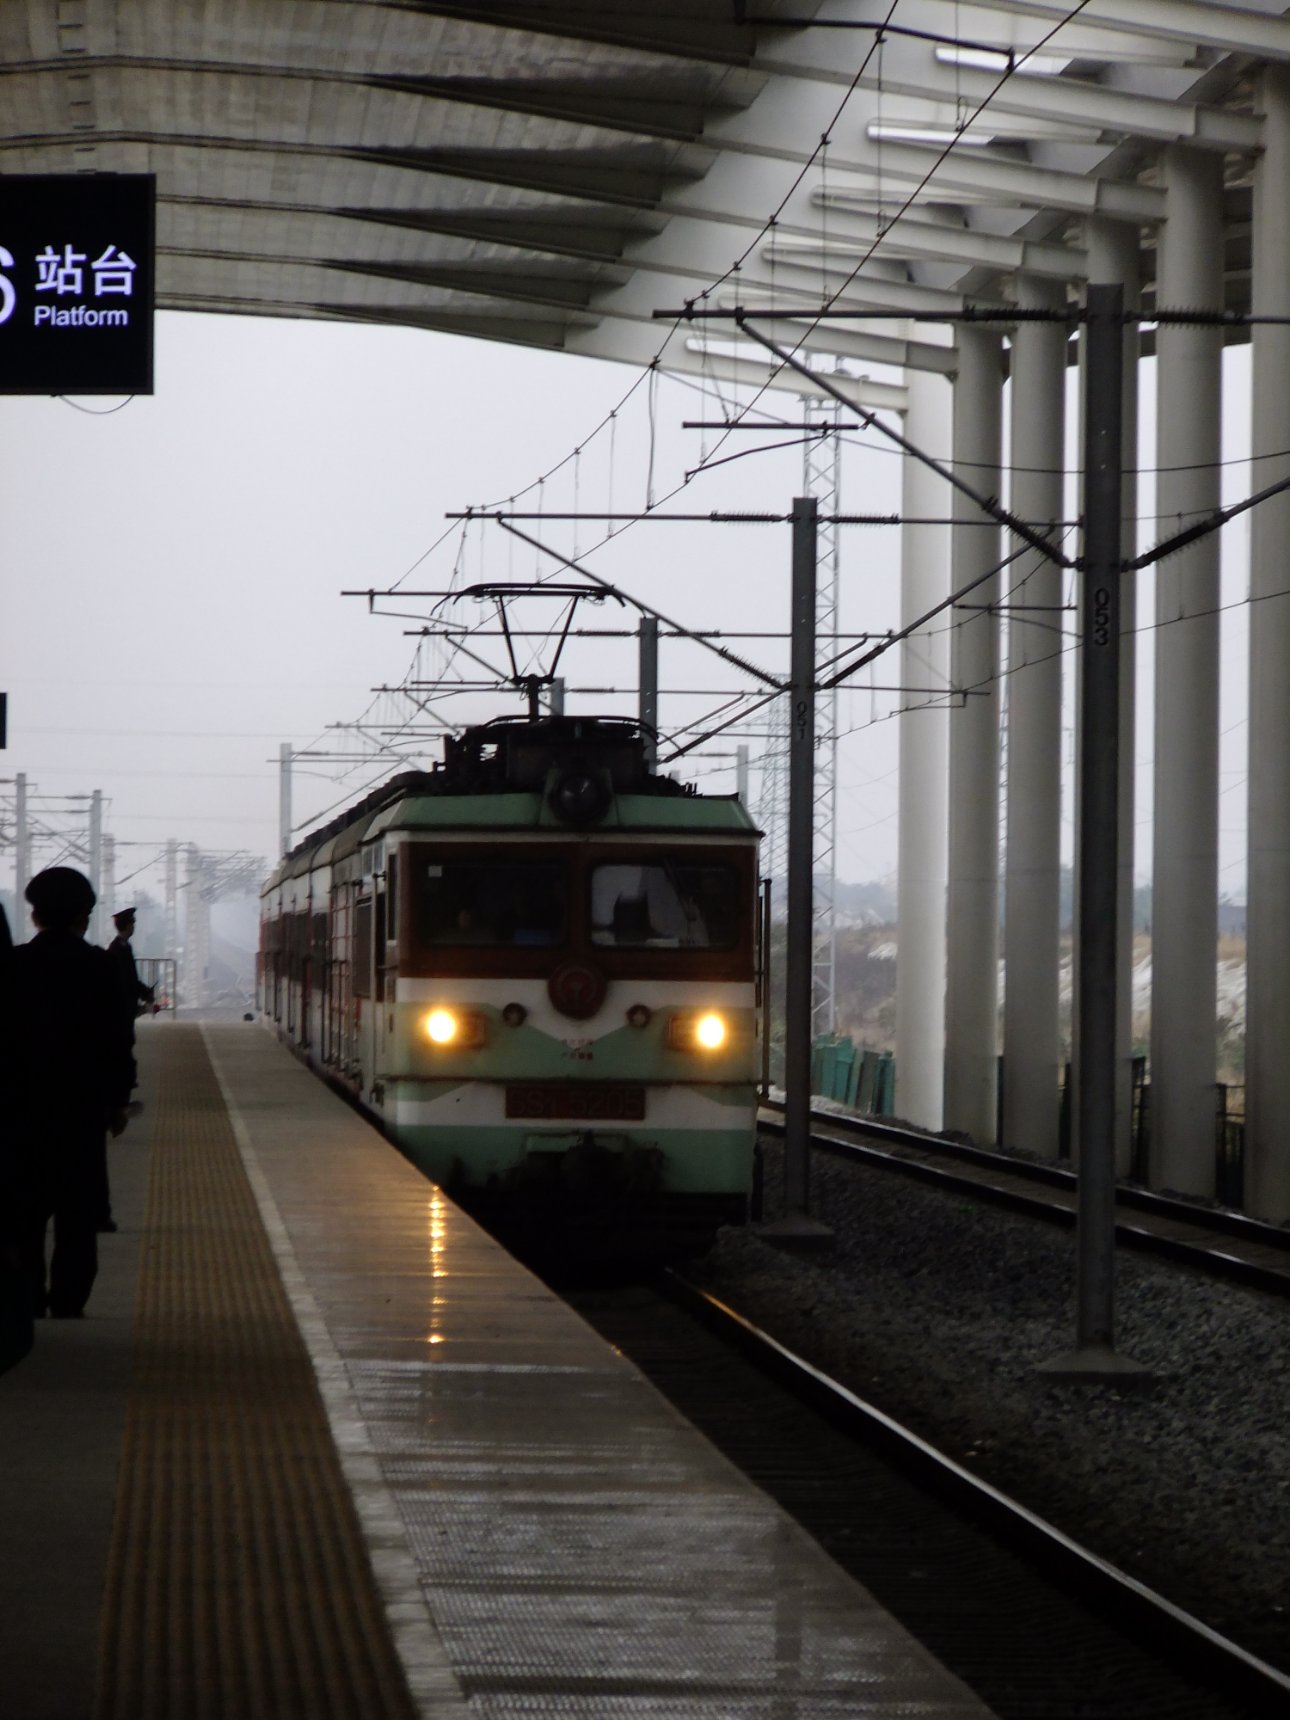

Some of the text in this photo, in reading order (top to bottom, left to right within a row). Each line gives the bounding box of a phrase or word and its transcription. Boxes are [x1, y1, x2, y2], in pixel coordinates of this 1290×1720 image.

[34, 243, 137, 297] 站台
[33, 304, 129, 327] Platform
[1094, 587, 1110, 646] 053
